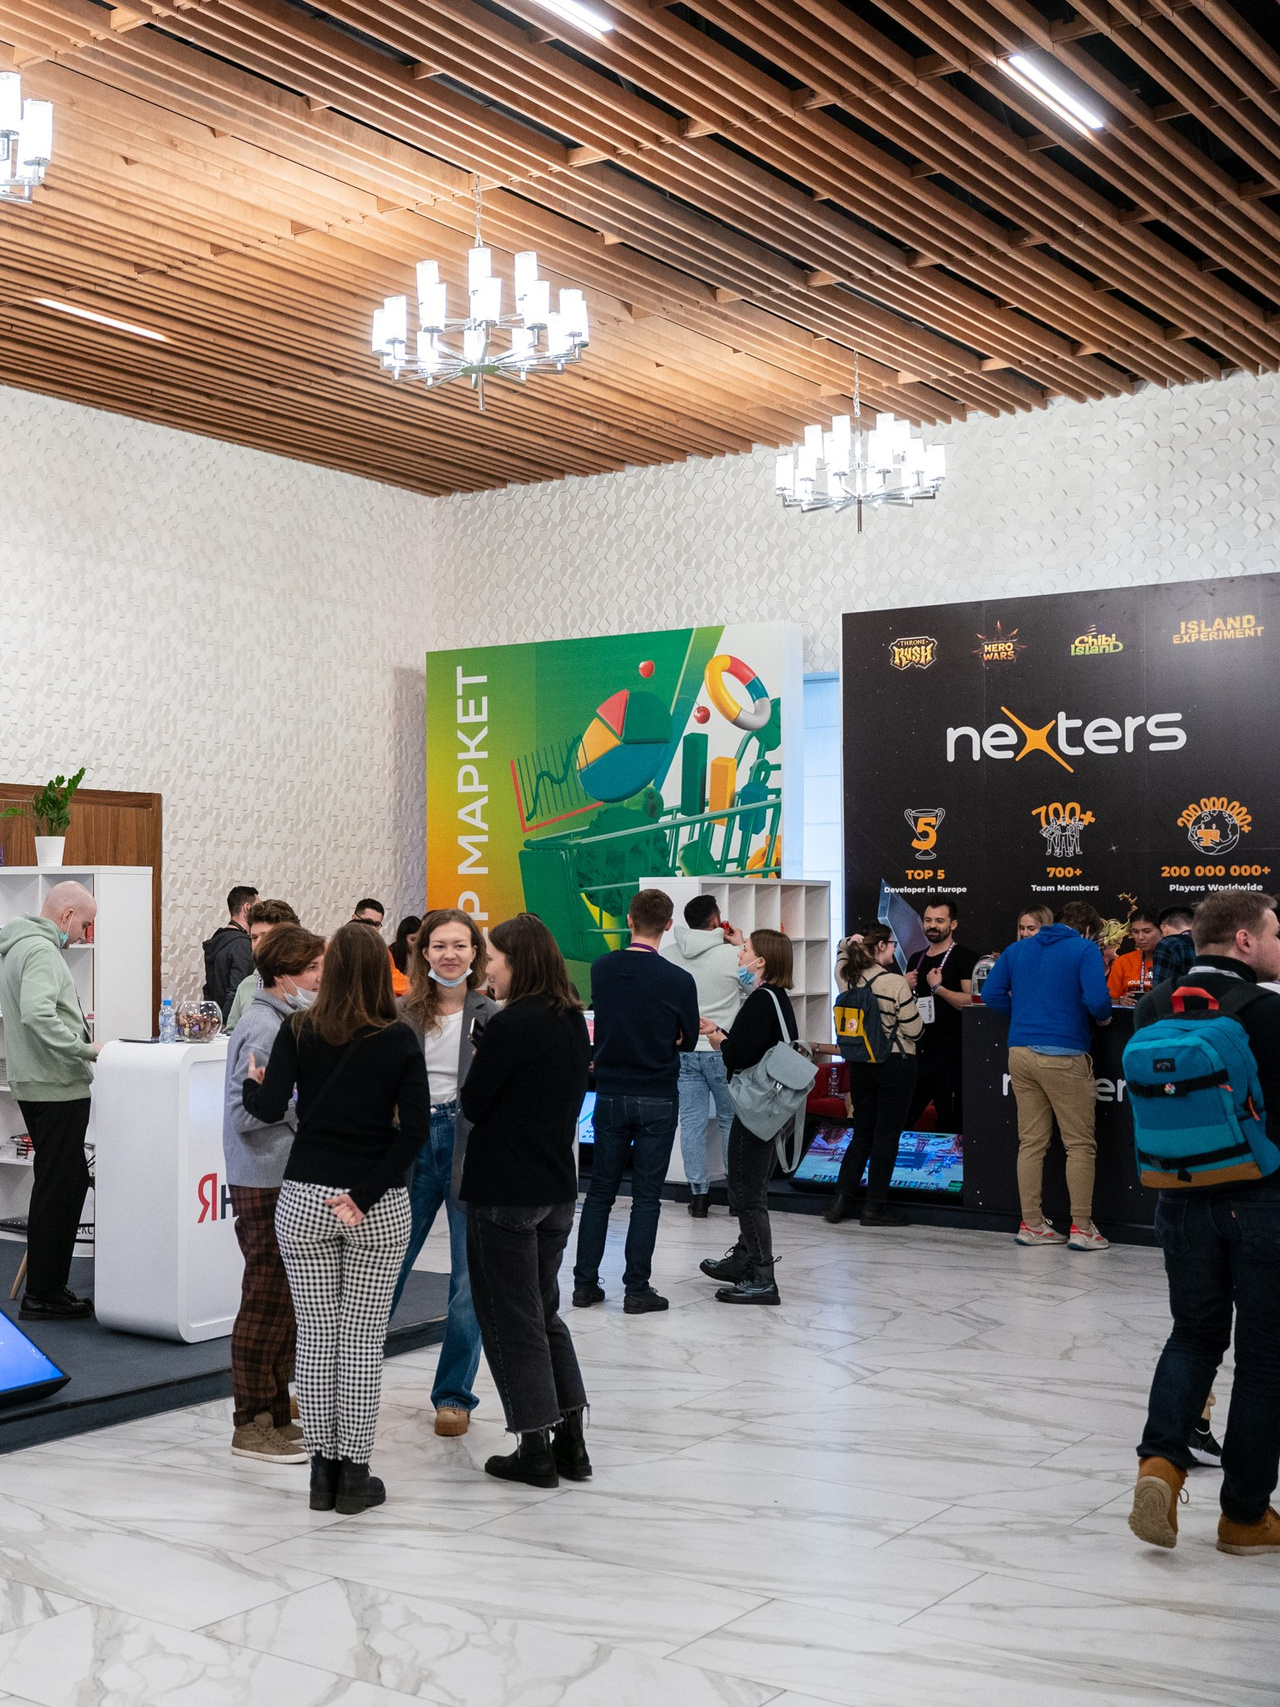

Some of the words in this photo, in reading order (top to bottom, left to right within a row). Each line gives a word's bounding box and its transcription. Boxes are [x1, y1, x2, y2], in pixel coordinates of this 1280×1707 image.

[1180, 614, 1256, 635] ISLAND
[1074, 633, 1117, 648] Chibi
[1172, 626, 1265, 645] EXPERIMENT
[984, 642, 1014, 652] HERO
[892, 643, 934, 667] RUSH
[983, 651, 1015, 661] WARS
[946, 705, 1188, 774] nexters
[456, 666, 489, 875] МАРКЕТ
[911, 816, 938, 850] 5
[905, 869, 934, 880] TOP
[937, 869, 946, 880] 5
[1046, 867, 1083, 878] 700+
[1160, 865, 1191, 877] 200
[1194, 865, 1226, 877] 000
[1230, 864, 1271, 877] 000+
[884, 886, 926, 895] Developer
[927, 885, 936, 893] in
[937, 886, 968, 894] Europe
[1031, 884, 1055, 892] Team
[1057, 884, 1100, 893] Members
[1169, 884, 1206, 893] Players
[1207, 883, 1263, 891] Worldwide
